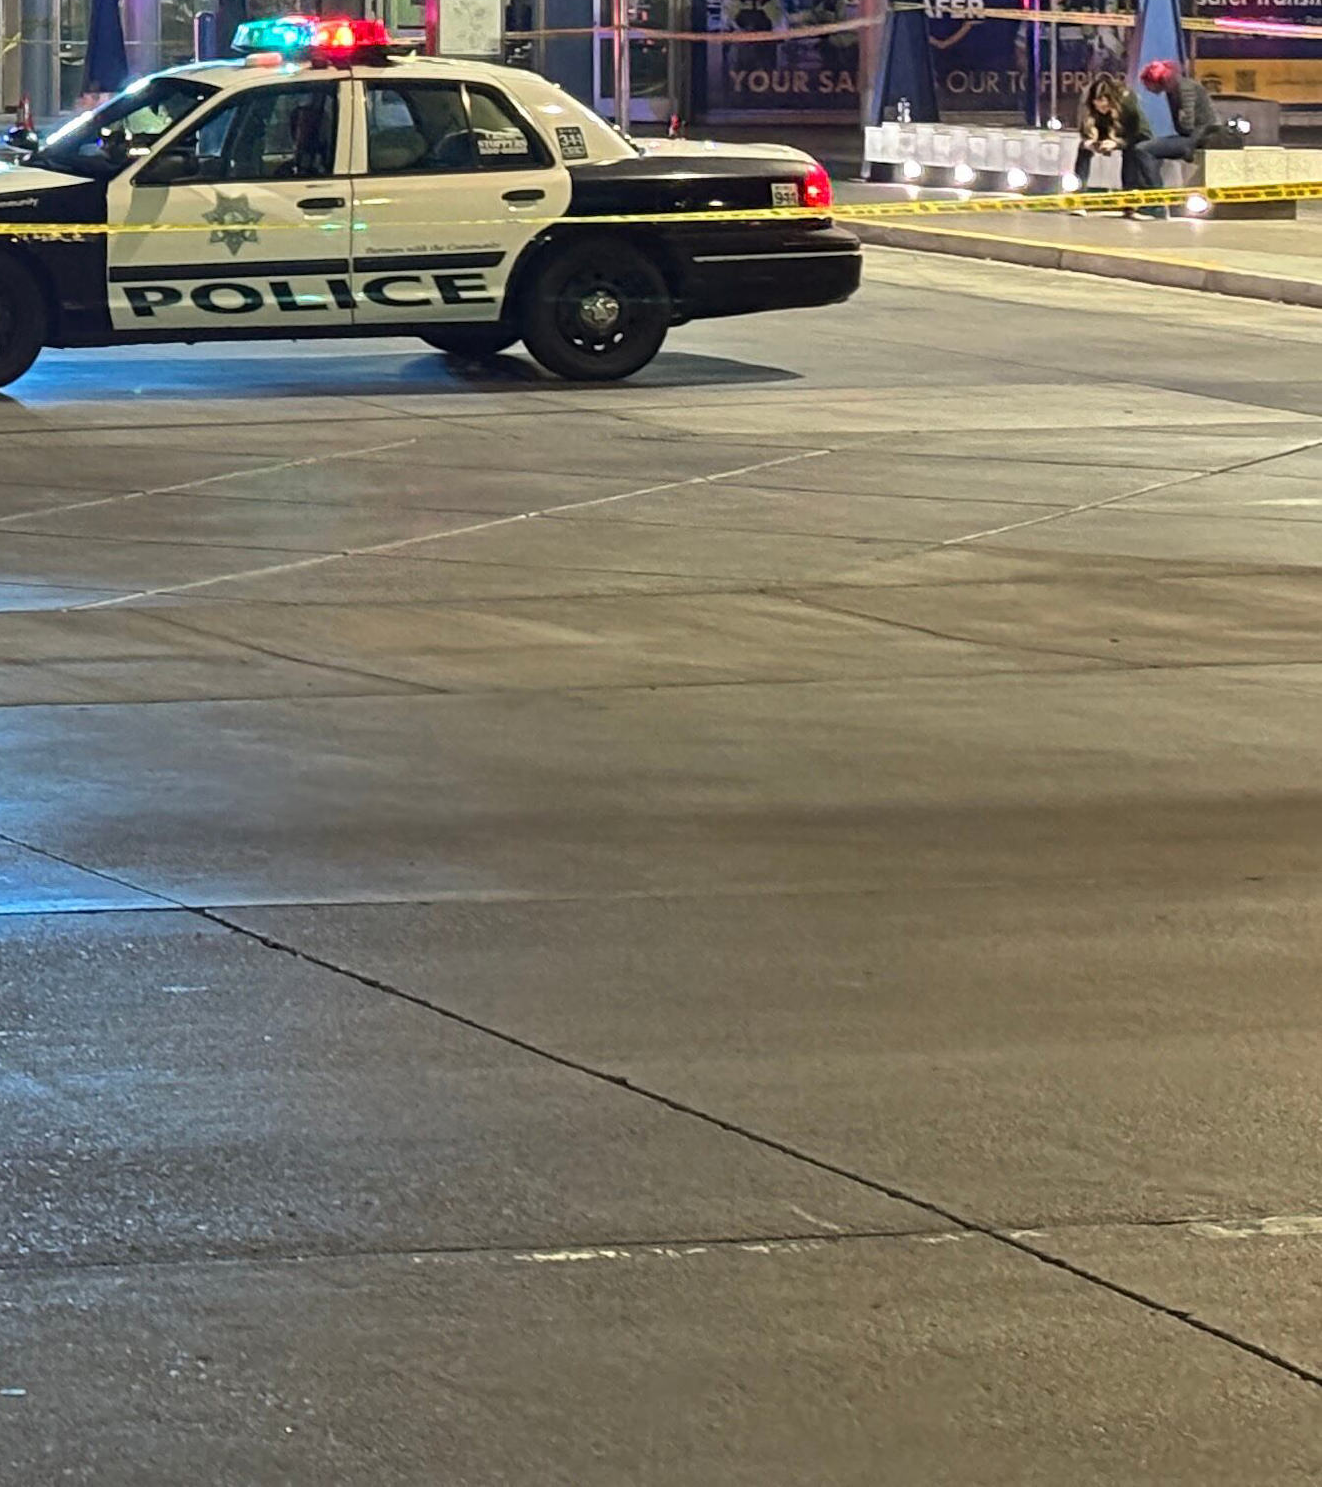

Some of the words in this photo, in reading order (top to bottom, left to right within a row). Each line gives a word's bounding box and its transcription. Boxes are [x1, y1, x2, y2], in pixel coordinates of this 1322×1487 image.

[729, 70, 810, 93] YOUR
[946, 70, 1000, 94] OUR
[122, 273, 496, 318] POLICE
